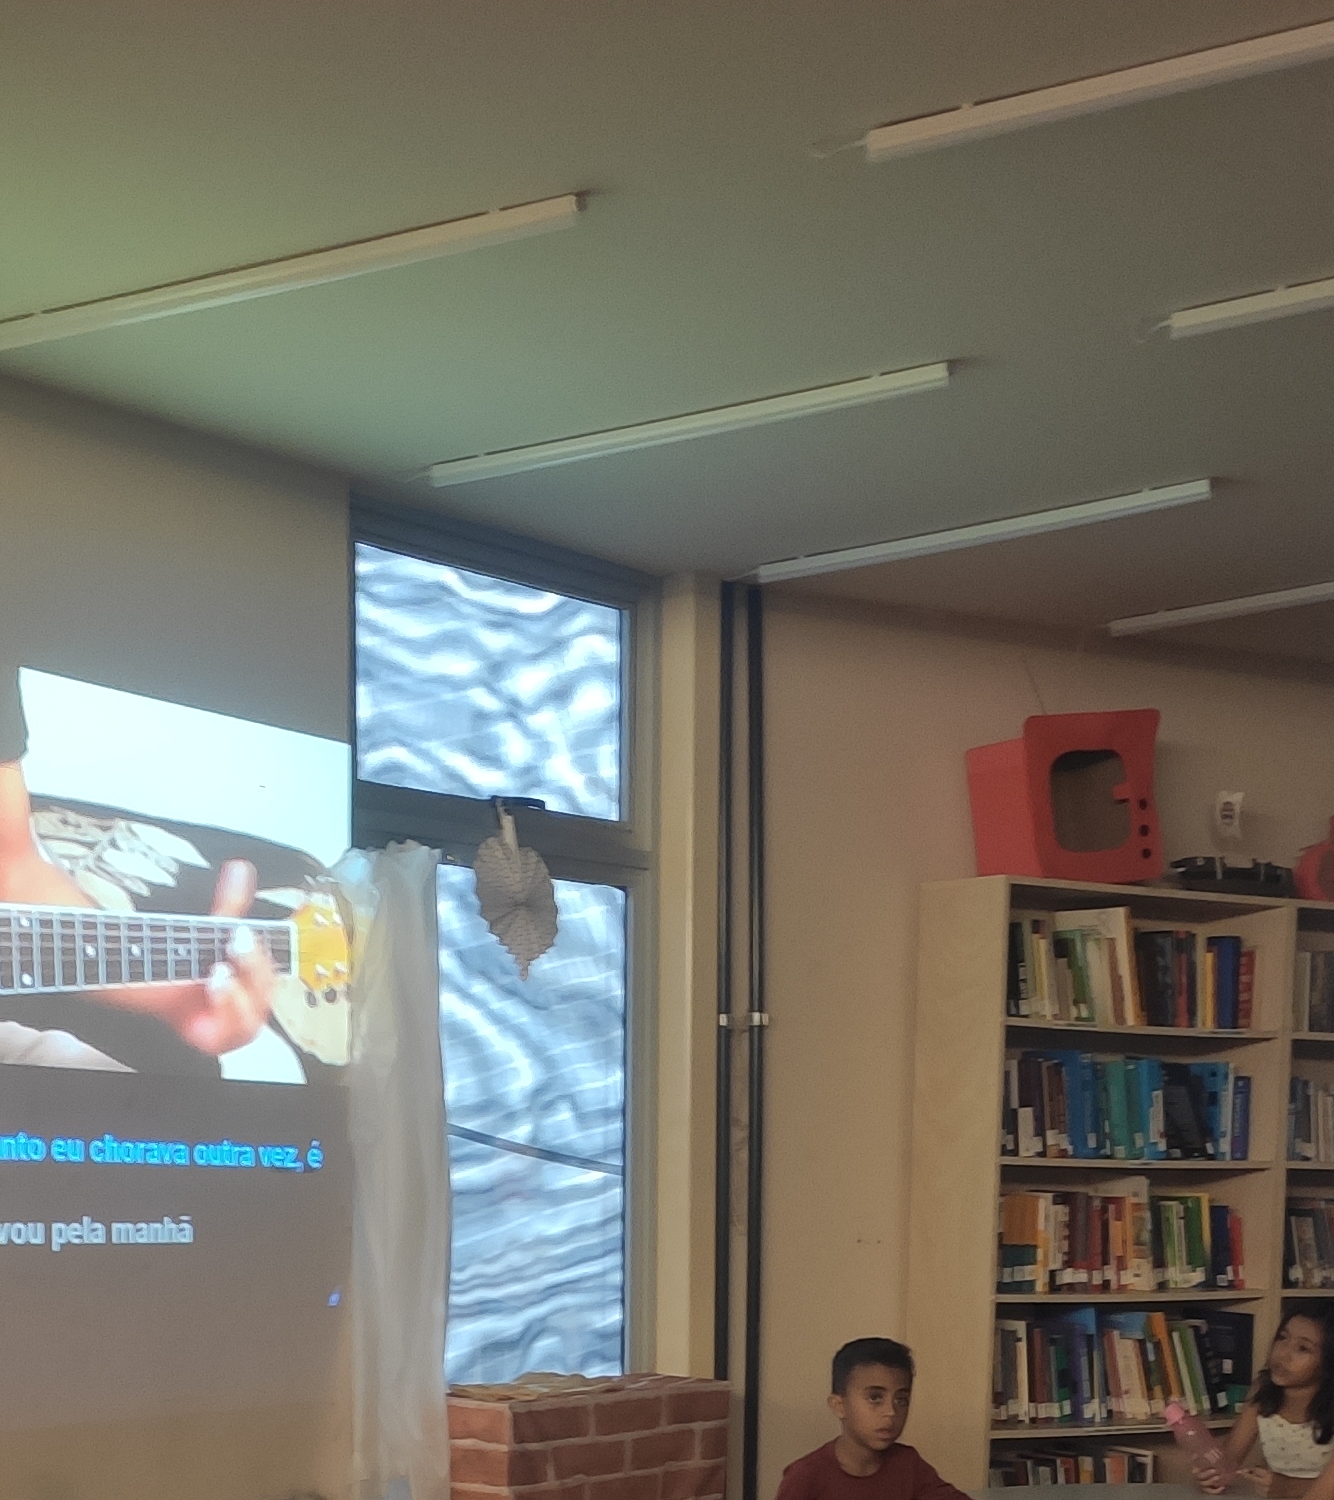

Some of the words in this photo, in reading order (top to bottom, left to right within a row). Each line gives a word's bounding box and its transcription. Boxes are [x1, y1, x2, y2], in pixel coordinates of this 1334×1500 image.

[51, 1136, 85, 1164] eu
[89, 1133, 191, 1167] chorava
[193, 1139, 256, 1169] outra
[258, 1144, 305, 1173] vez,
[307, 1140, 325, 1170] é
[51, 1215, 107, 1252] pela
[111, 1215, 194, 1246] manhã
